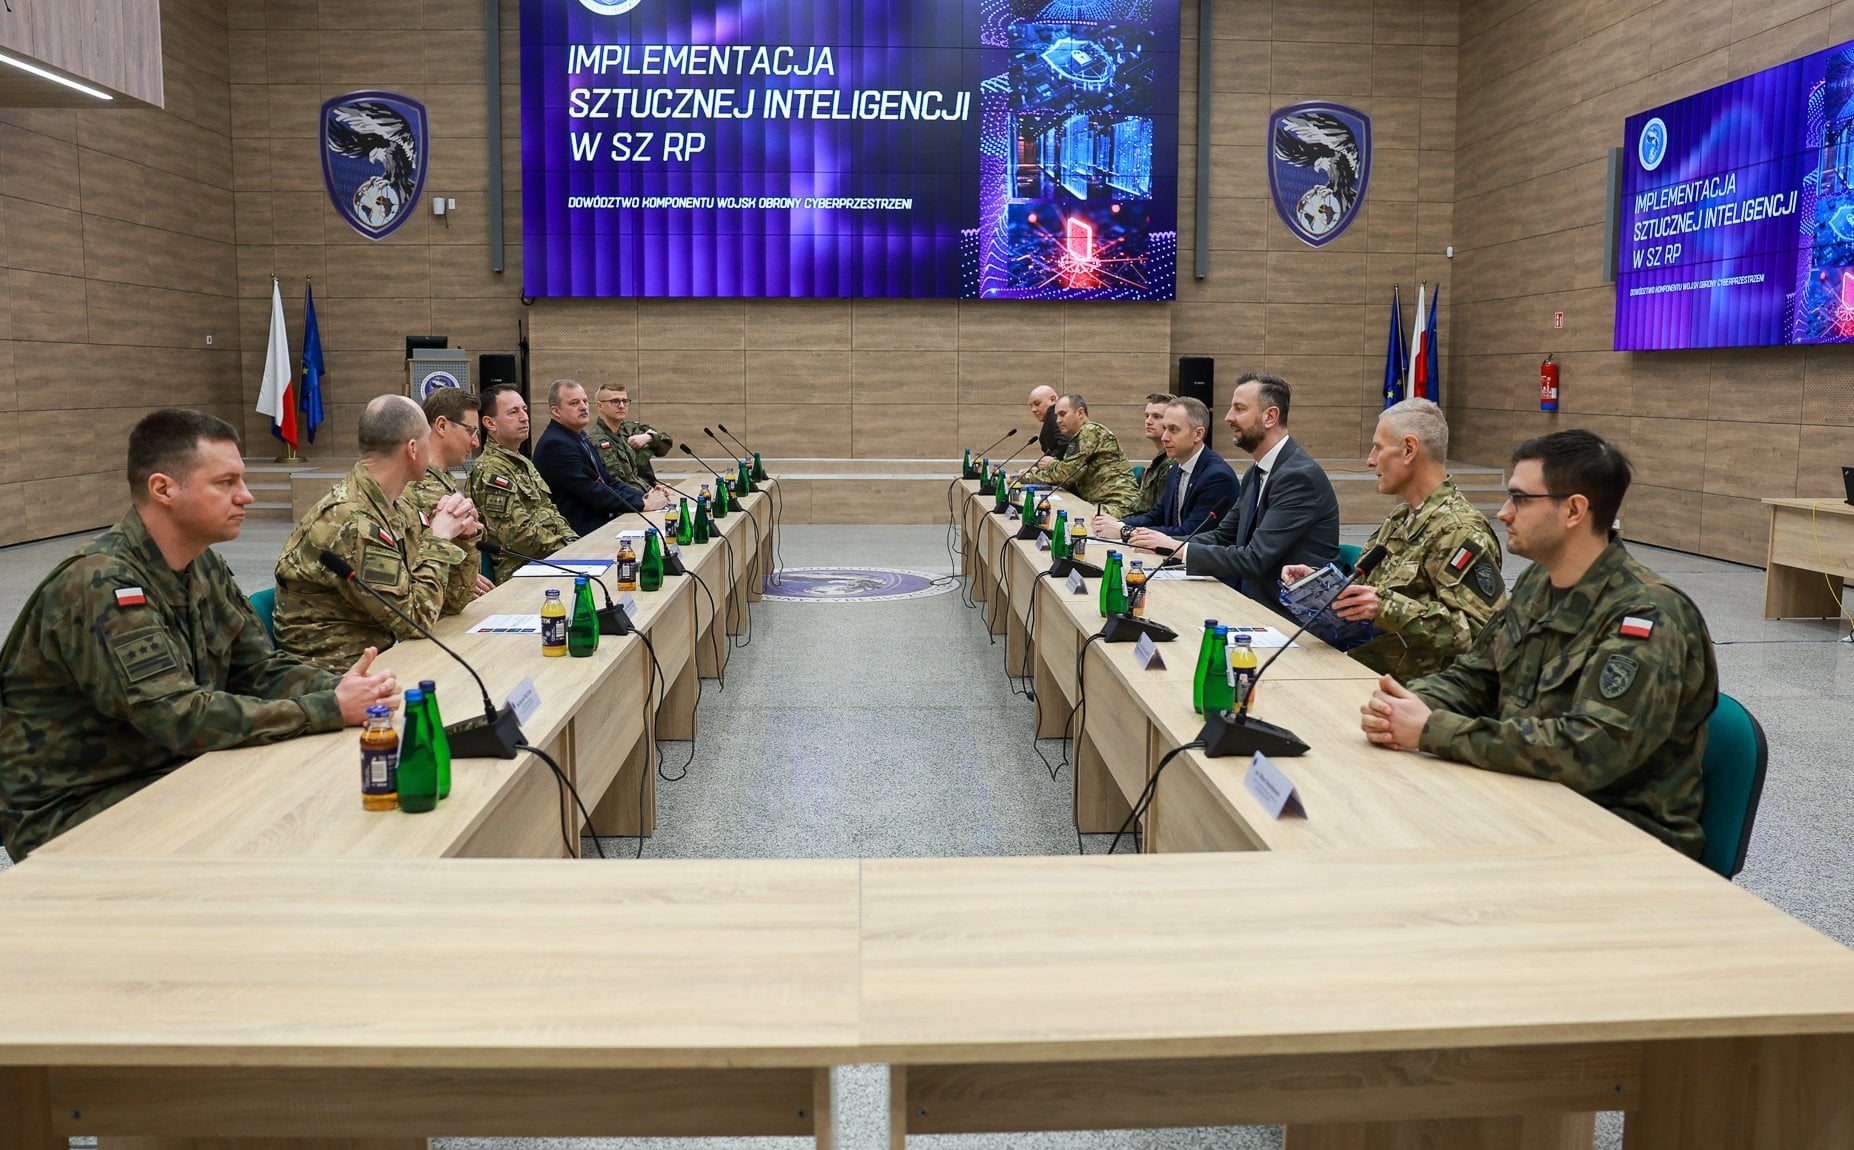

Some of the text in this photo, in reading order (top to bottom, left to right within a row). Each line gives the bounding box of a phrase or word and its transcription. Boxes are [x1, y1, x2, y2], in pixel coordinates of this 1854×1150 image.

[568, 44, 835, 76] IMPLEMENTACJA
[569, 88, 971, 121] SZTUCZNEJ INTELIGENCJI
[570, 132, 706, 162] W SZ RP
[568, 195, 913, 210] DOWÓDZTWO KOMPONENTU WOJSK OBRONY CYBERPRZESTRZENI
[1634, 172, 1737, 215] IMPLEMENTACJA
[1633, 190, 1798, 241] SZTUCZNEJ INTELIGENCJI
[1633, 243, 1682, 269] W SZ RP
